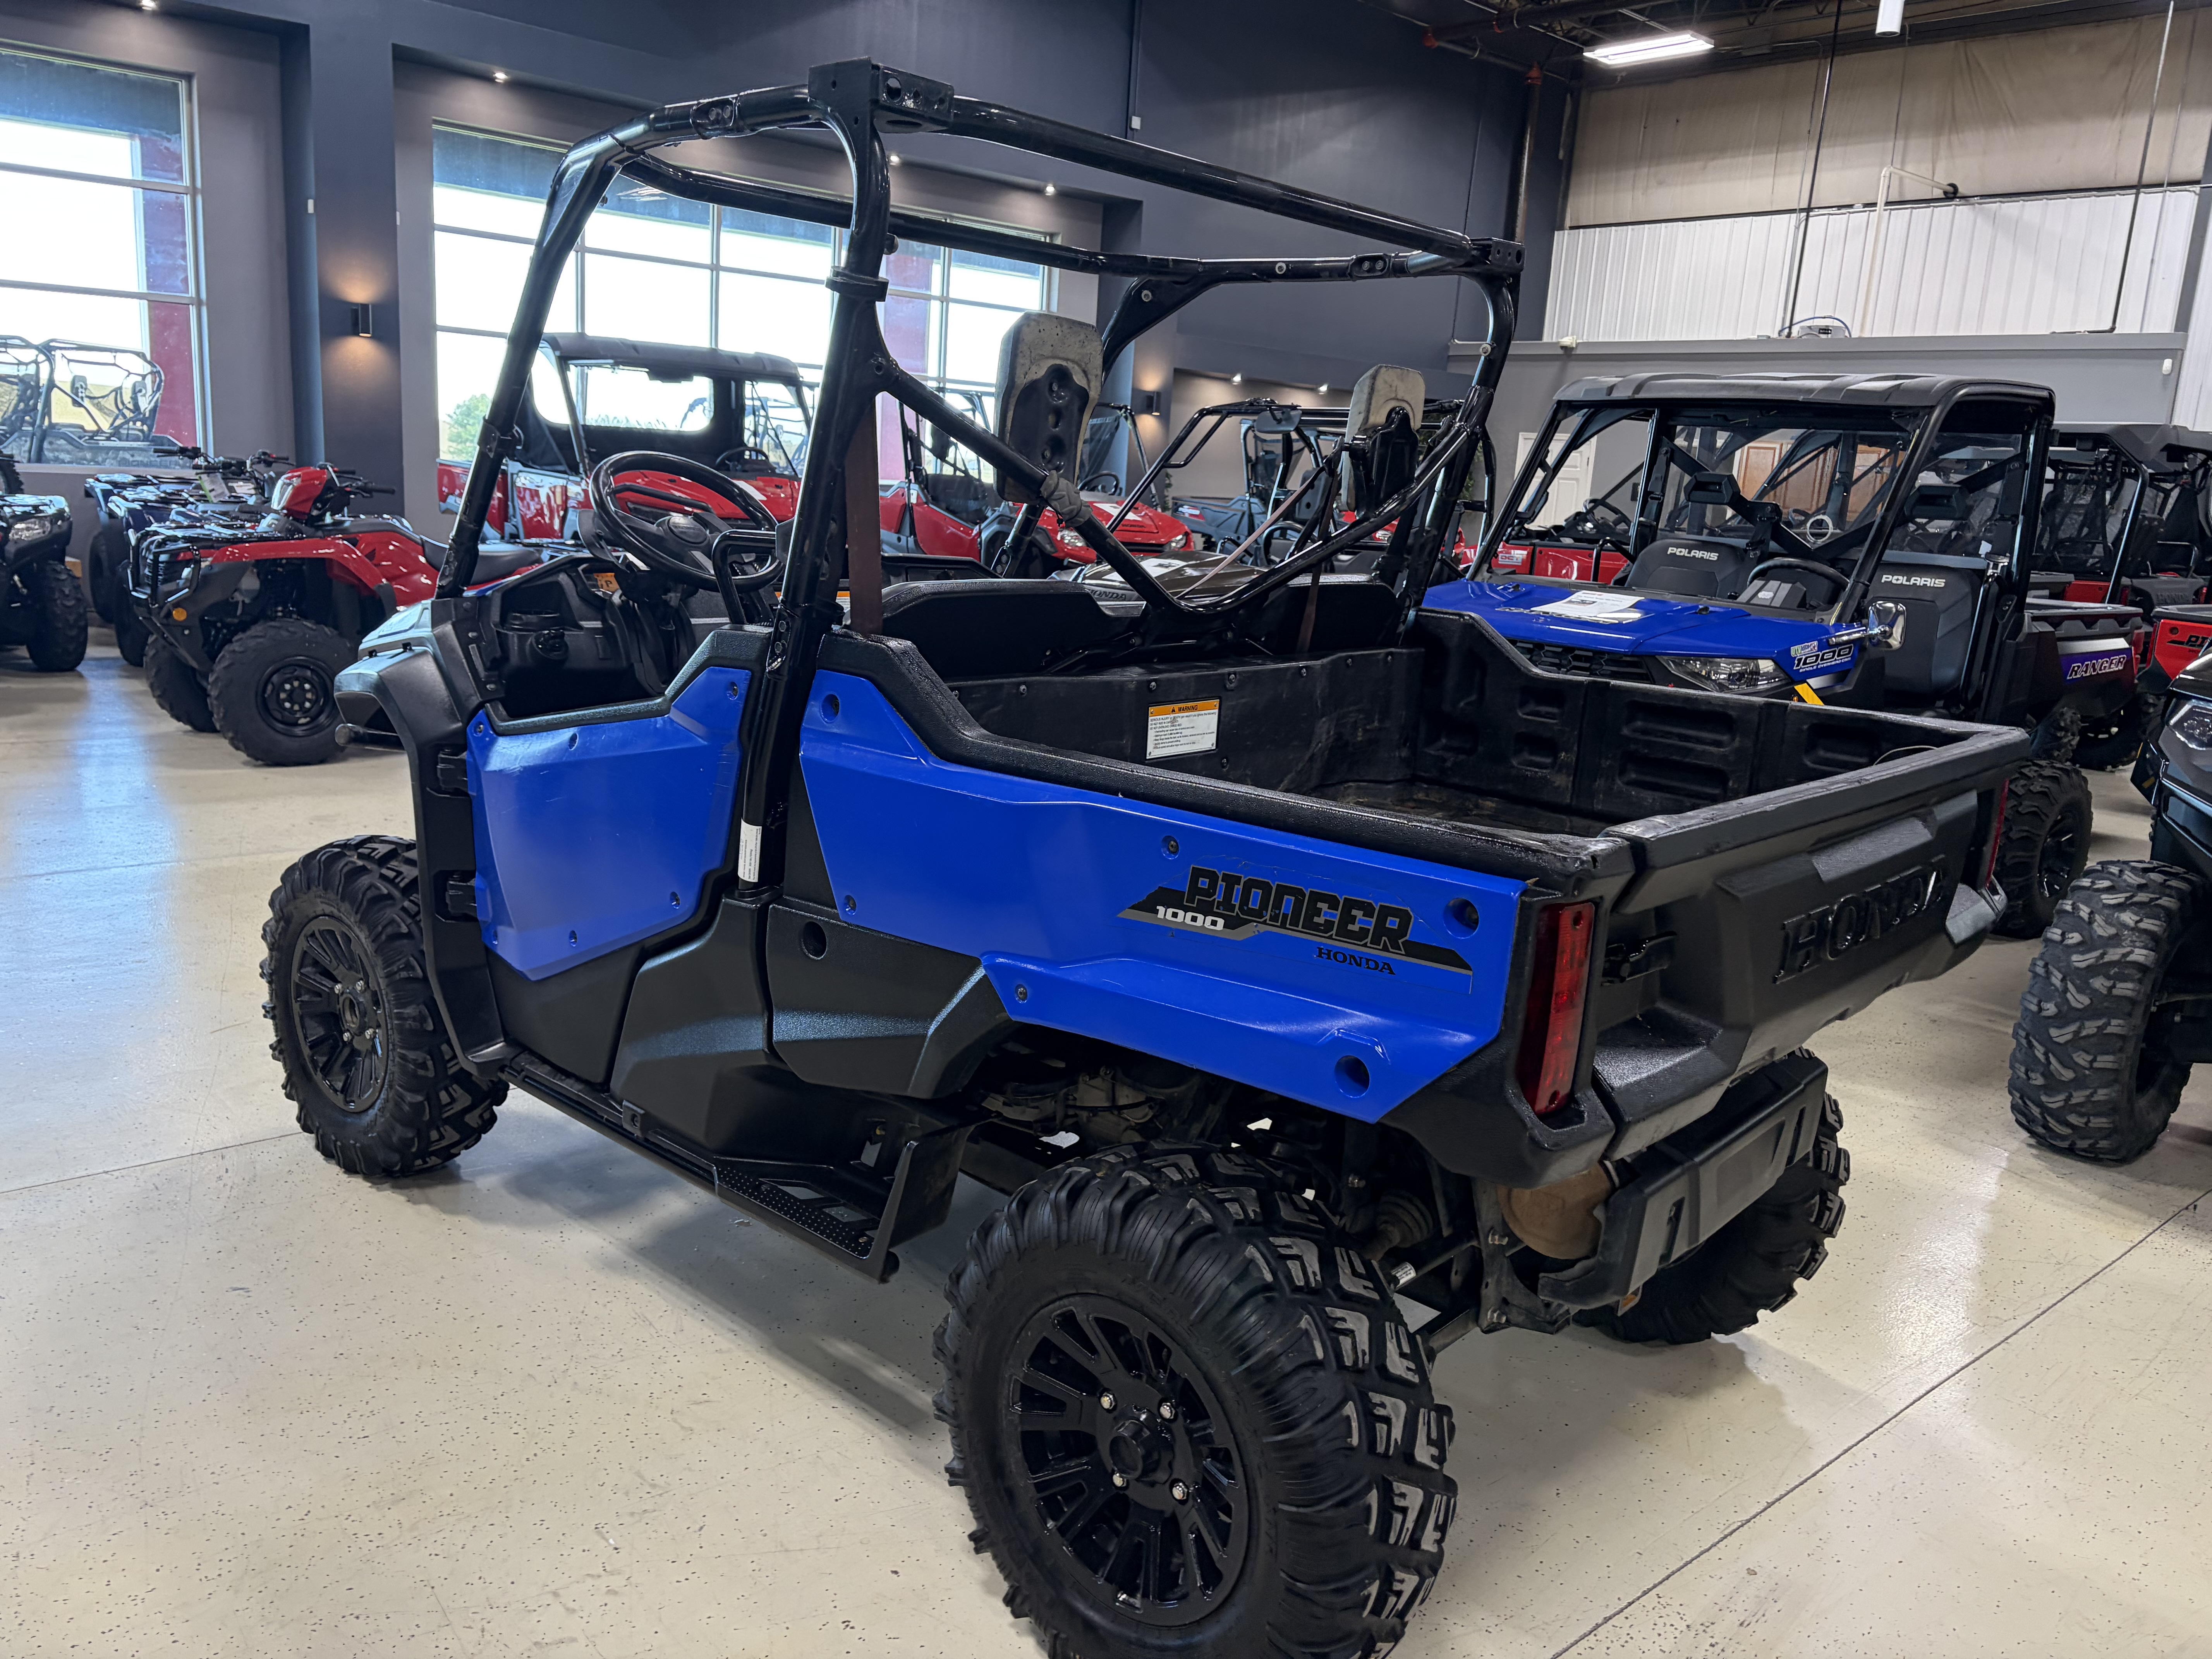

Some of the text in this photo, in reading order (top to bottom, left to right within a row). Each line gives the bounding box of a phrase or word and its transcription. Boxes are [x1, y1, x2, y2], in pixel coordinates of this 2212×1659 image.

[1667, 546, 1719, 561] POLARIS
[1881, 574, 1946, 588] POLARIS
[1793, 644, 1854, 670] 1000
[2066, 655, 2127, 680] RANGER
[1156, 905, 1224, 931] 1000
[1184, 865, 1414, 954] PIONEER
[1772, 854, 1946, 984] HONDA
[1317, 947, 1396, 975] HONDA
